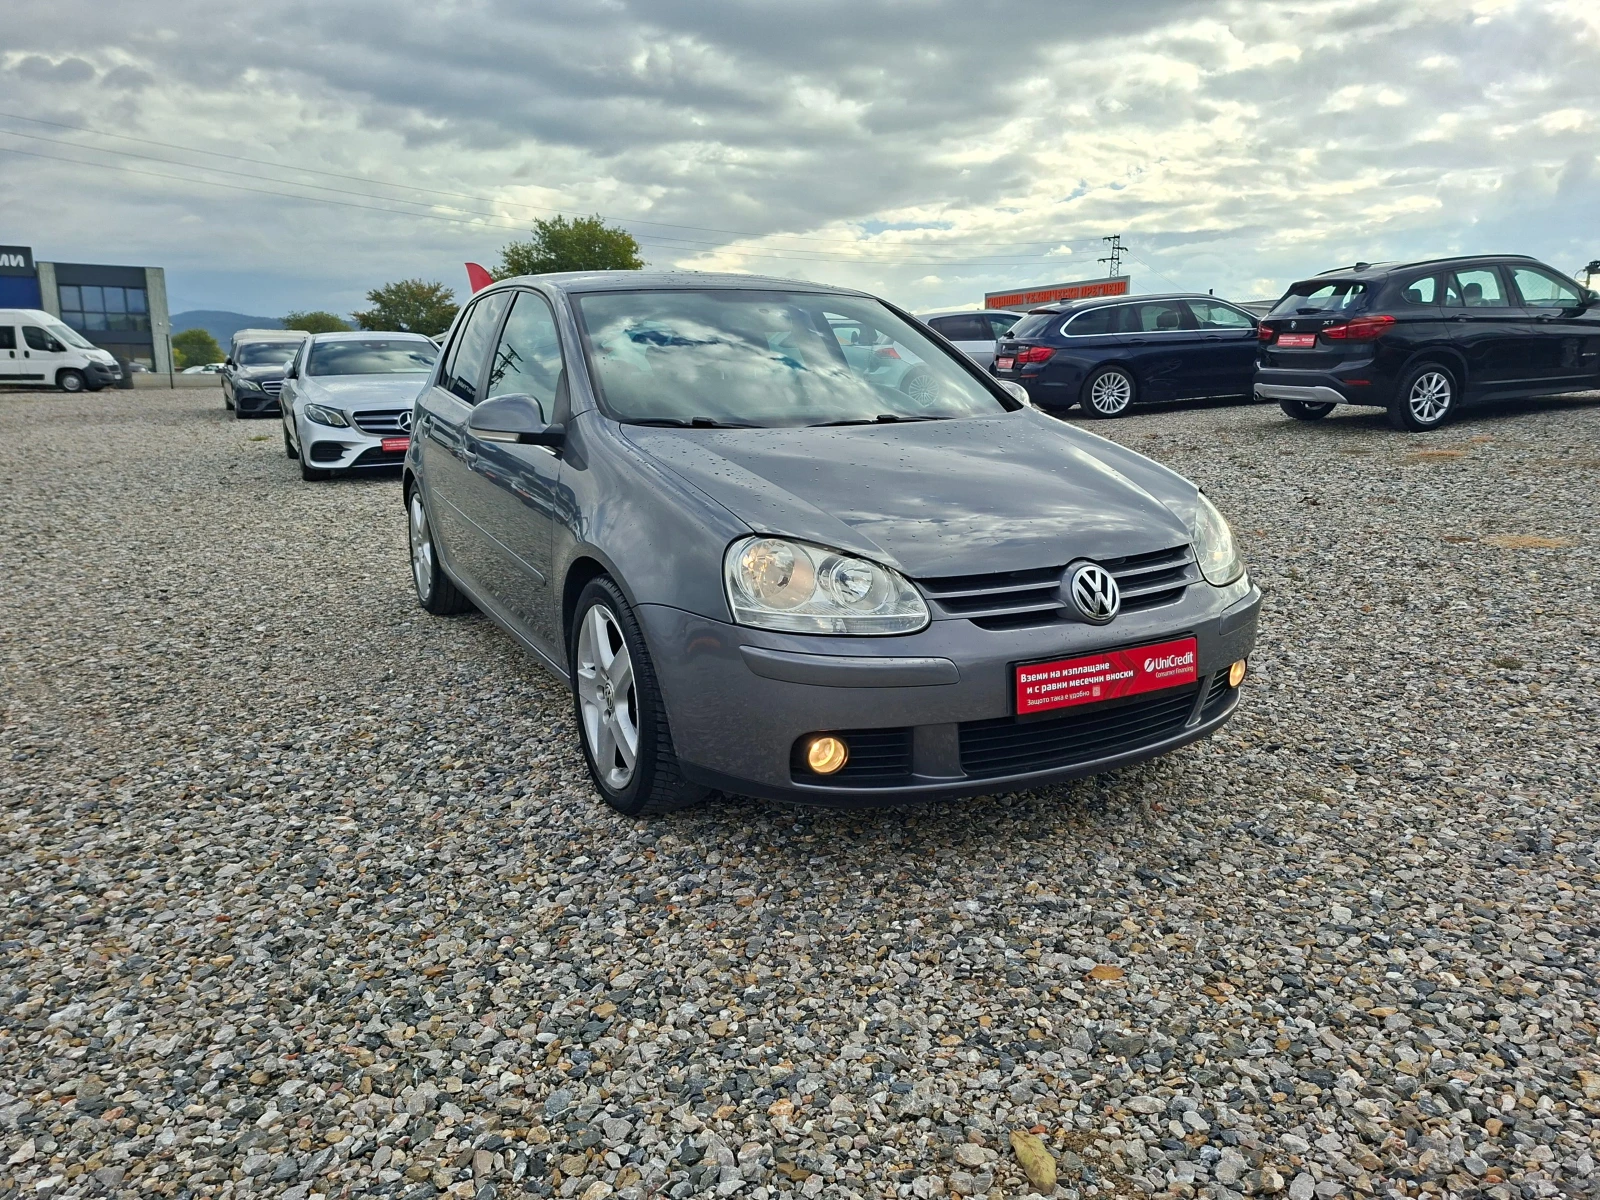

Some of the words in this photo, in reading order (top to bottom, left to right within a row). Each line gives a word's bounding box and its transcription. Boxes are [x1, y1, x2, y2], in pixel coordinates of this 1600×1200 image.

[987, 294, 1024, 309] ГОДИШНИ
[1155, 651, 1193, 670] UniCredit
[1020, 672, 1048, 683] Вземи
[1050, 670, 1061, 678] на
[1062, 662, 1110, 676] изплащане
[1155, 669, 1176, 678] Consumer
[1175, 665, 1194, 674] Financing
[1027, 686, 1033, 694] и
[1034, 685, 1040, 693] с
[1041, 681, 1068, 694] равни
[1069, 675, 1104, 687] месечни
[1105, 670, 1134, 681] вноски
[1027, 697, 1050, 706] Защото
[1051, 694, 1064, 702] така
[1069, 690, 1090, 700] удобно
